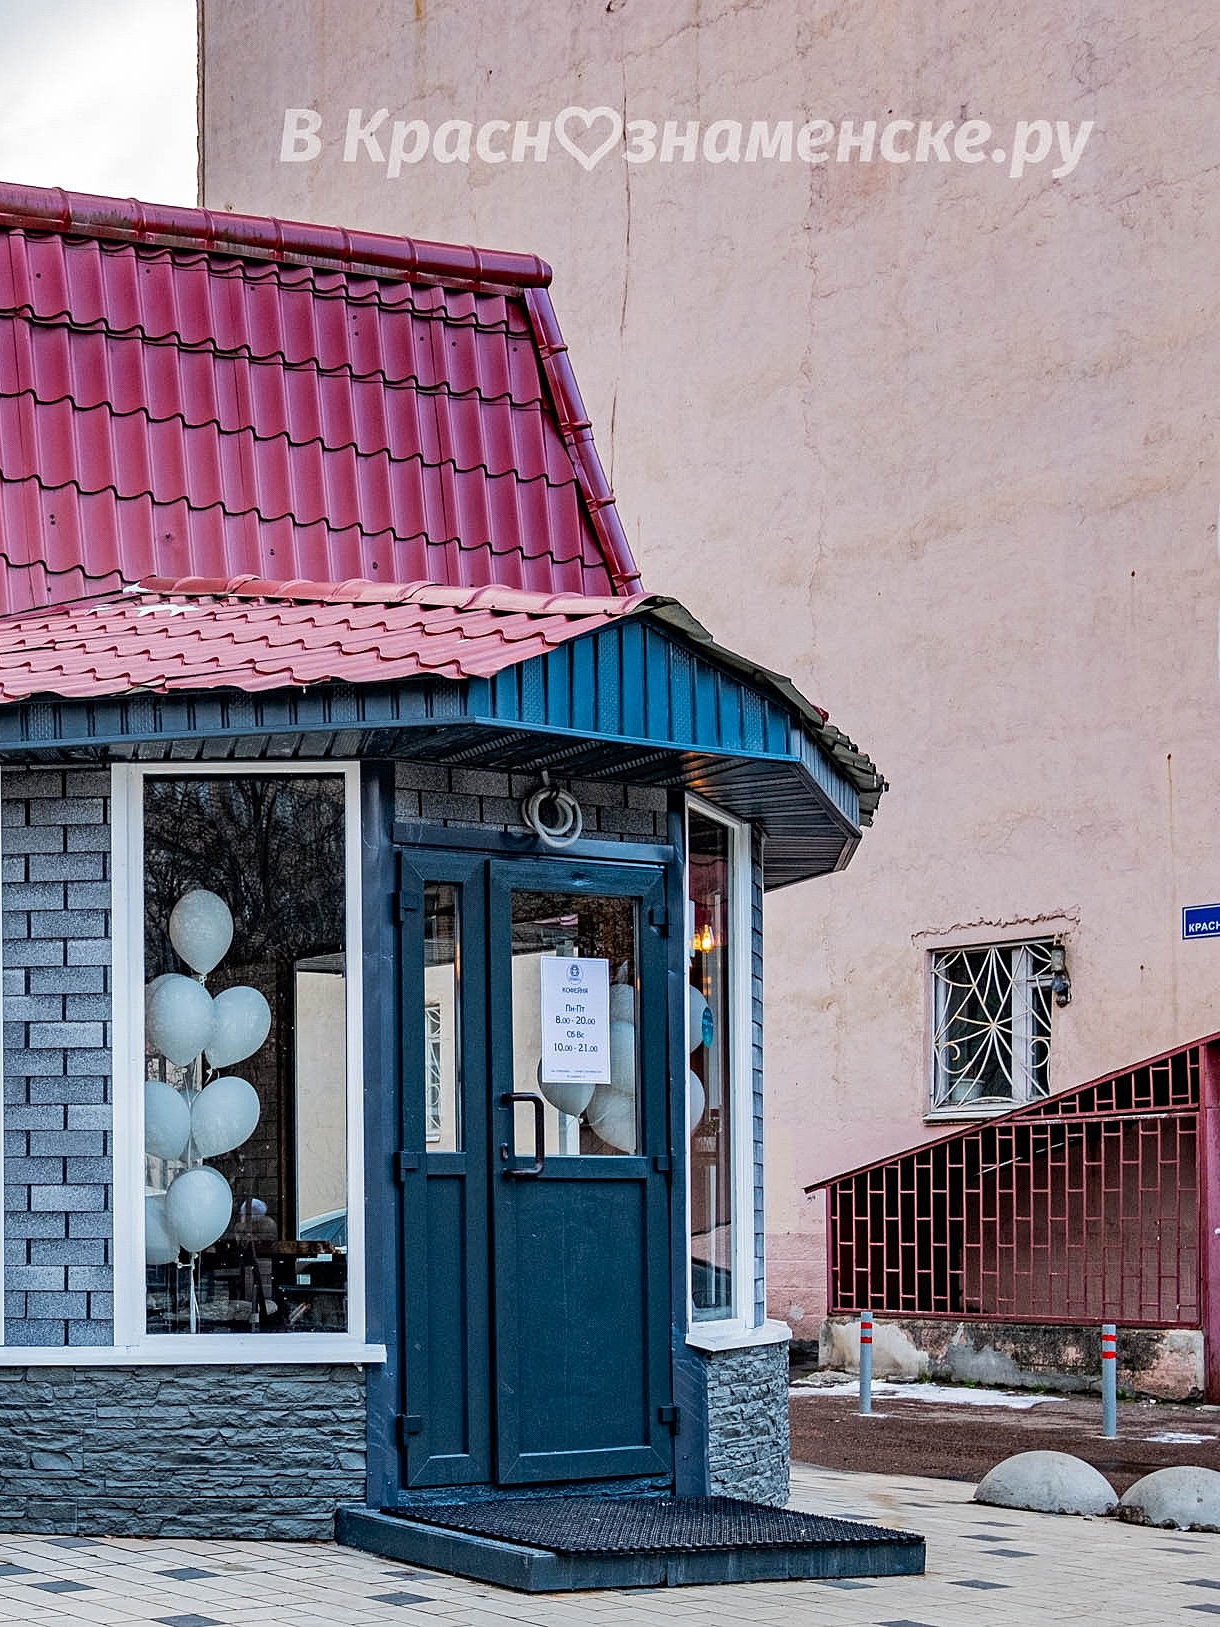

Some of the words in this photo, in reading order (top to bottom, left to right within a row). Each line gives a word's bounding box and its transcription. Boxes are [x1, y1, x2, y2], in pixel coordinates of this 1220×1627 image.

[555, 1015, 571, 1025] 8.00
[575, 1015, 596, 1025] 20.00
[554, 1042, 573, 1052] 10.00
[578, 1043, 599, 1053] 21.00
